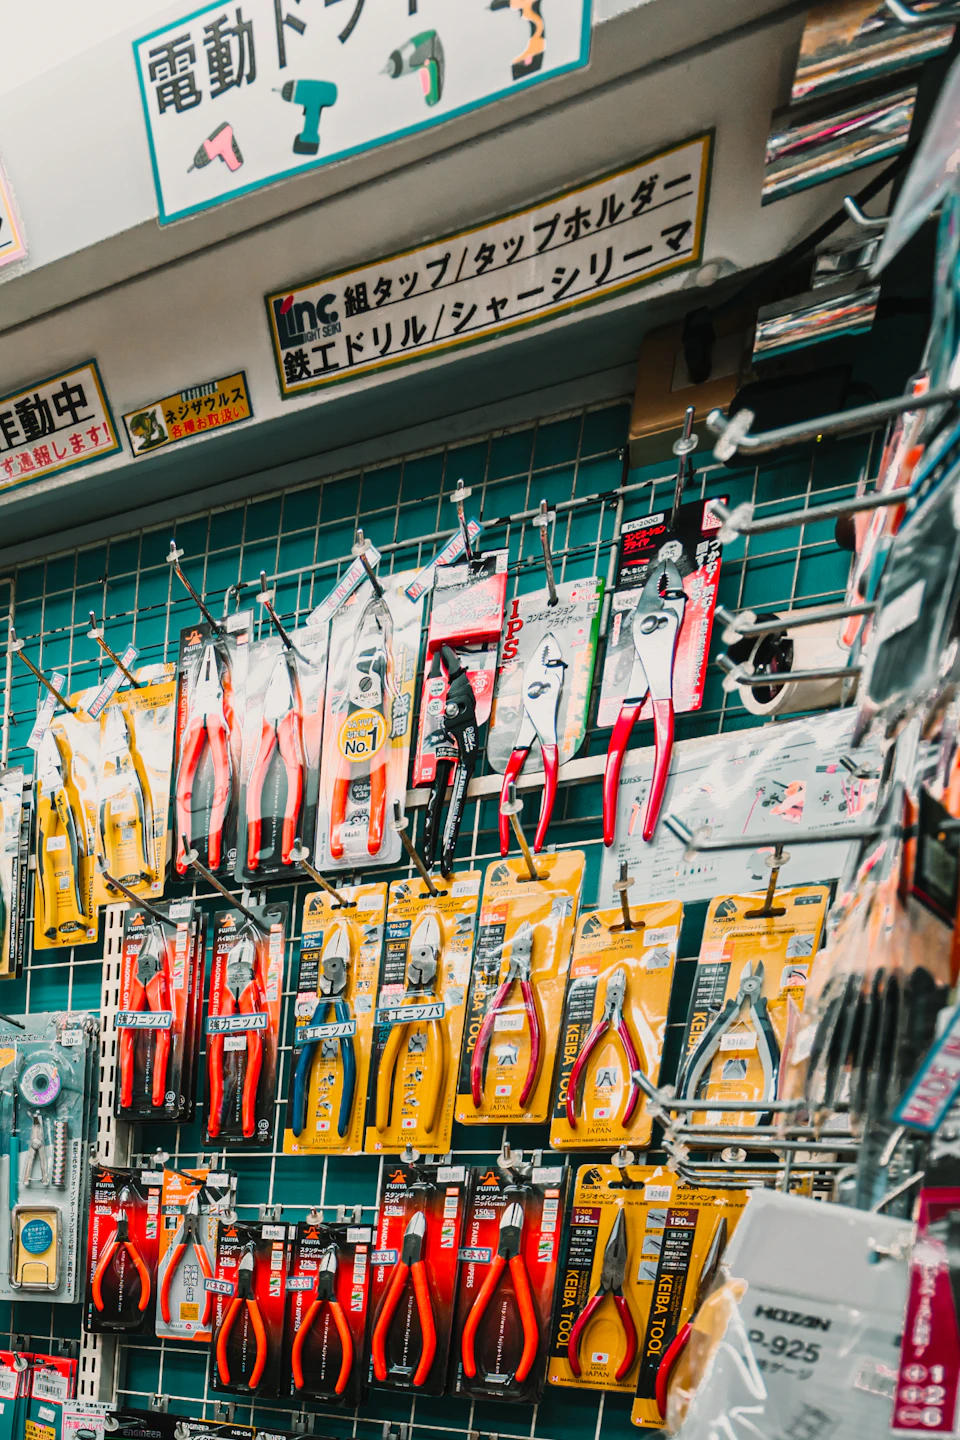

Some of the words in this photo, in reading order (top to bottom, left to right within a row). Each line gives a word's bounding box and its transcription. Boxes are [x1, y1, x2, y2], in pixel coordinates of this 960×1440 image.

[344, 172, 692, 318] 組タップ/タップホルダー
[166, 385, 246, 425] ネジザウルス
[170, 403, 248, 440] 各種お取扱い
[118, 1013, 168, 1027] 強力ニッパ
[209, 1014, 264, 1031] 強力ニッパ
[565, 1023, 581, 1066] KEIBA
[95, 1181, 115, 1190] FUJIYA
[385, 1182, 408, 1191] FUJIYA
[476, 1184, 501, 1192] FUJIYA
[575, 1208, 593, 1216] T-305
[670, 1209, 691, 1218] T-306
[221, 1235, 239, 1243] FUJIYA
[563, 1269, 580, 1308] KEIBA
[655, 1273, 673, 1316] KEIBA
[555, 1311, 570, 1349] TOOL
[647, 1317, 664, 1358] TOOL
